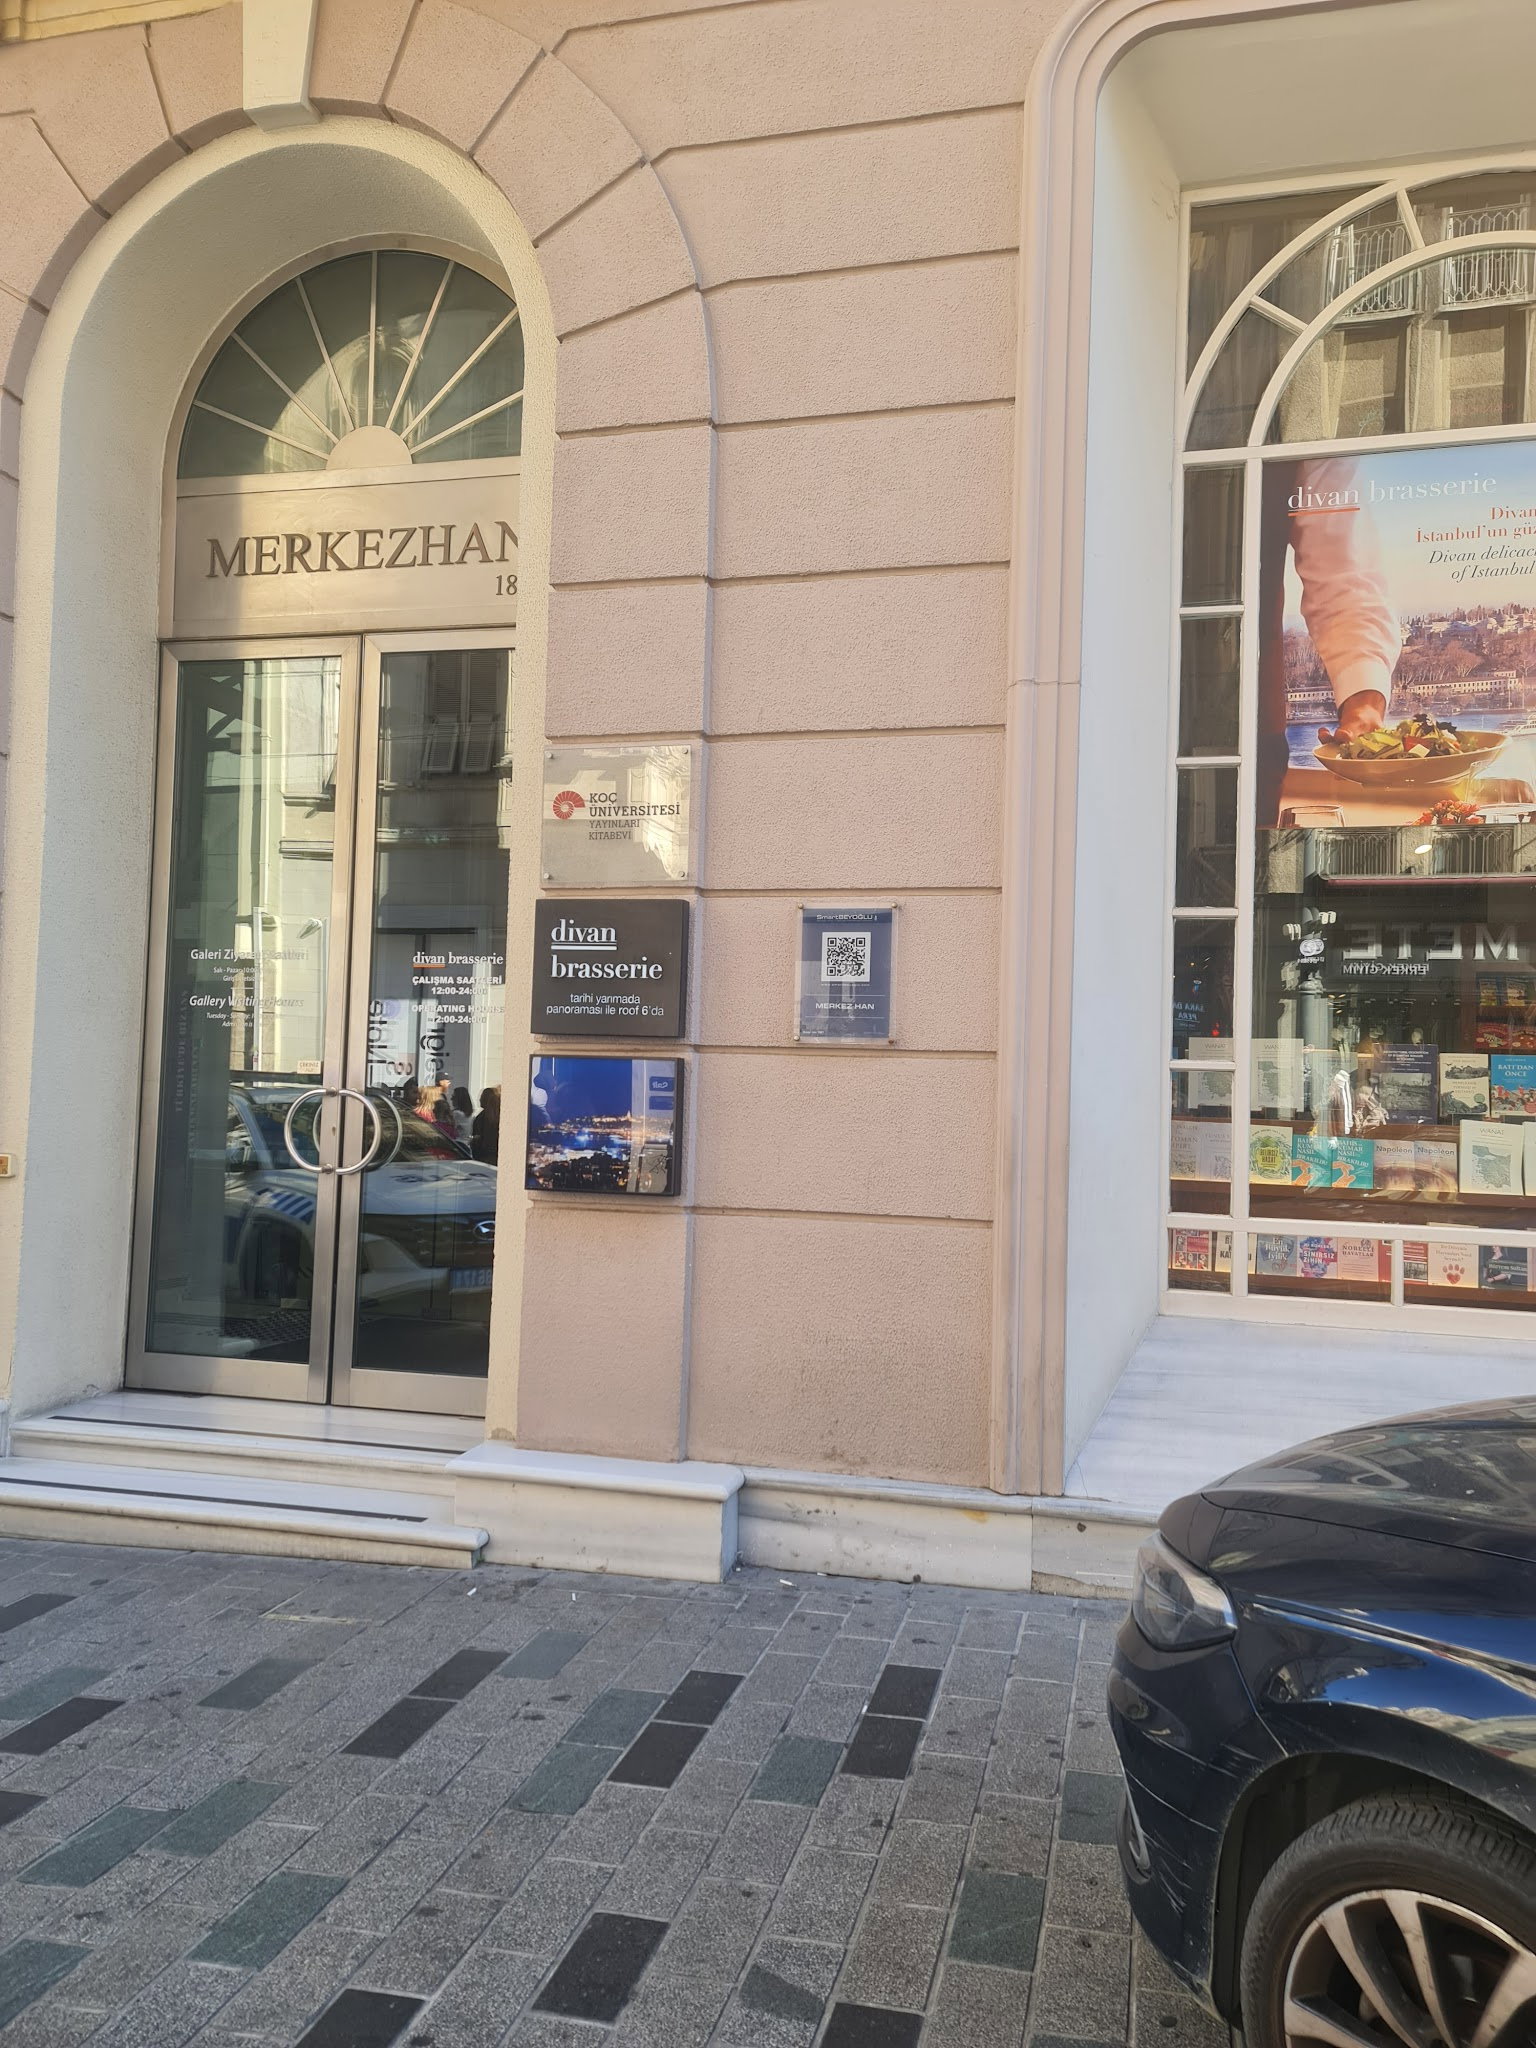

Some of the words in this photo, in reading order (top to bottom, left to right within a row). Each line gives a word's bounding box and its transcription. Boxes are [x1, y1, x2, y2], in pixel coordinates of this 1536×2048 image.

[1287, 486, 1360, 510] divan
[1368, 472, 1497, 502] brasserie
[1416, 524, 1508, 543] İstanbul'un
[1429, 549, 1476, 564] Divan
[1451, 565, 1471, 583] of
[1470, 561, 1536, 579] Istanbul
[589, 793, 617, 804] KOÇ
[589, 802, 680, 817] ÜNİVERSİTESİ
[589, 819, 640, 829] YAYINLARI
[551, 919, 617, 942] divan
[190, 949, 222, 960] Galeri
[413, 952, 445, 964] divan
[448, 952, 504, 965] brasserie
[551, 954, 663, 979] brasserie
[412, 976, 454, 985] ÇALIŞMA
[189, 995, 226, 1009] Gallery
[570, 993, 593, 1003] tarihi
[596, 994, 640, 1005] yarımada
[411, 1005, 466, 1013] OPERATING
[546, 1005, 603, 1015] panoraması
[605, 1005, 616, 1014] ile
[618, 1006, 639, 1015] roof
[641, 1006, 664, 1016] 6'da
[815, 1002, 854, 1010] MERKEZ
